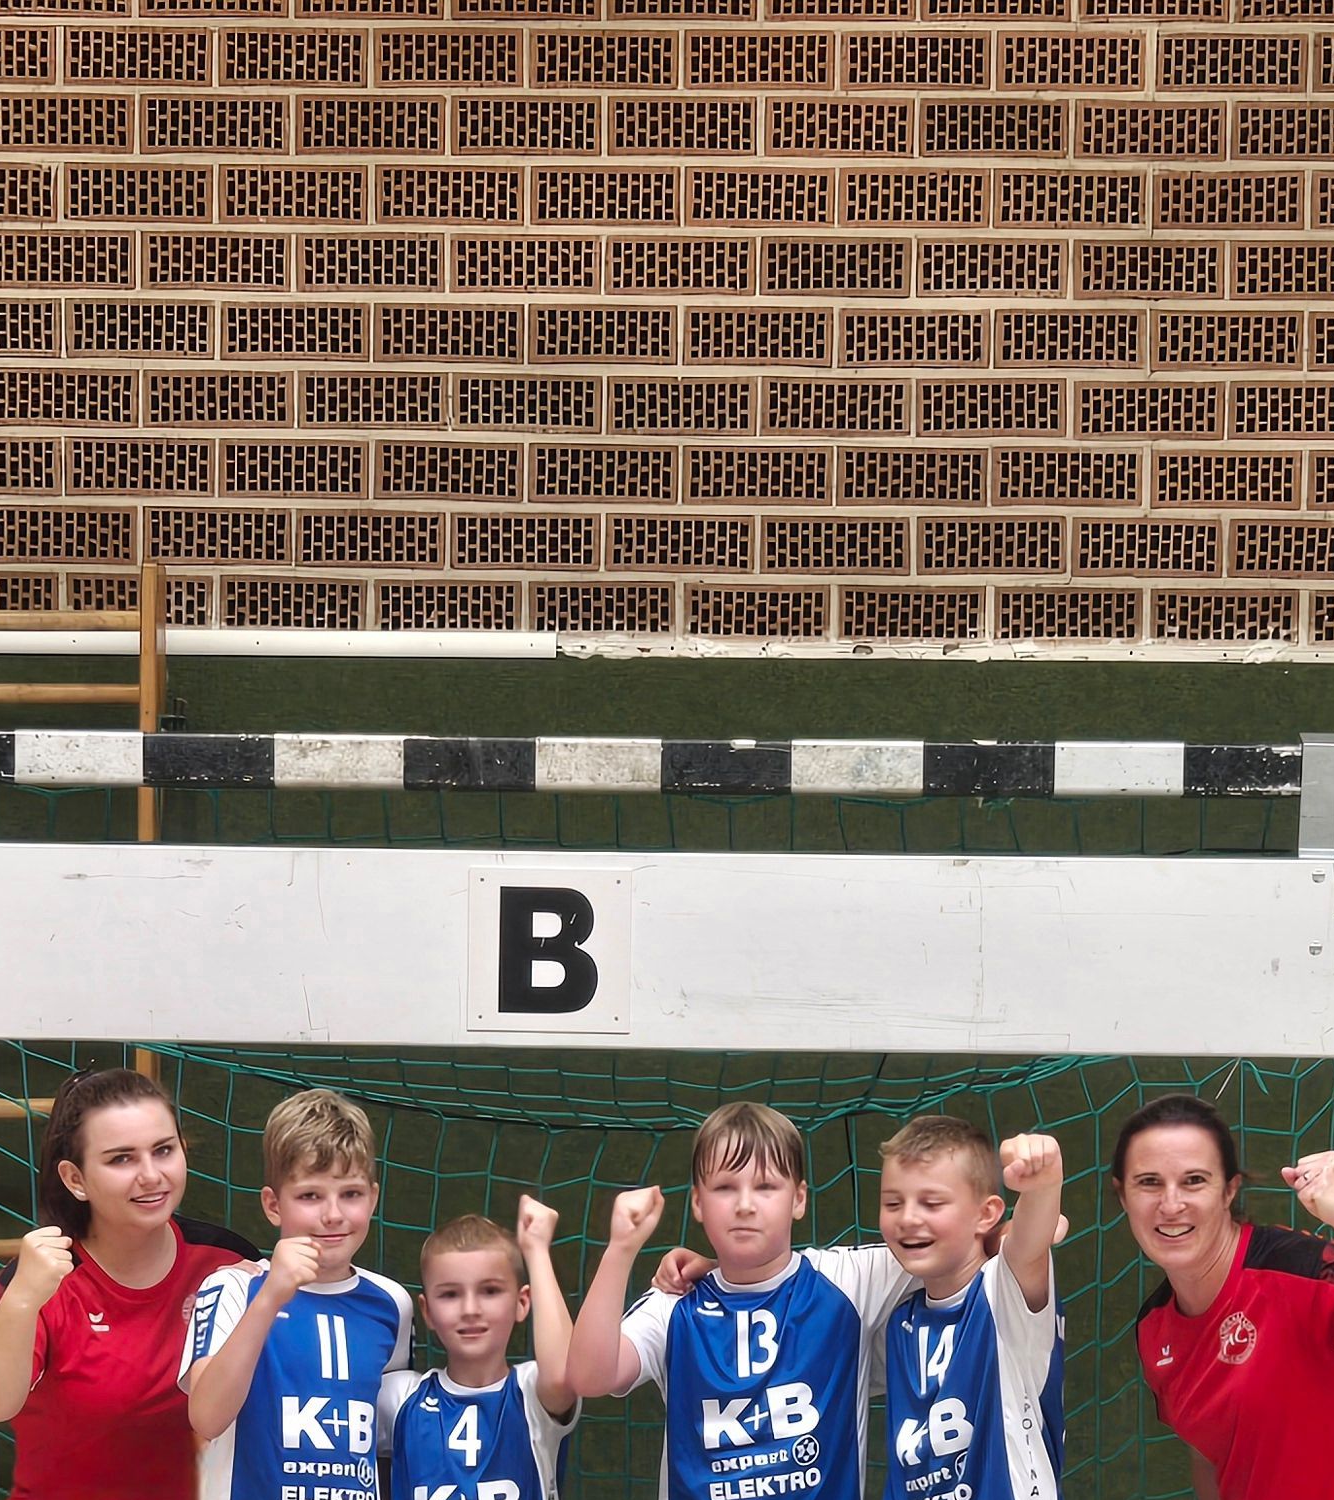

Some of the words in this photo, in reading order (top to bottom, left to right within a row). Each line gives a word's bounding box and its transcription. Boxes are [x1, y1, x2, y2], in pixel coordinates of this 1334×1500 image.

[498, 886, 599, 1014] B
[316, 1313, 349, 1380] 11
[736, 1309, 778, 1378] 13
[918, 1324, 958, 1396] 14
[281, 1396, 375, 1454] K+B
[448, 1404, 482, 1467] 4
[701, 1382, 820, 1450] K+B
[711, 1449, 789, 1473] expert
